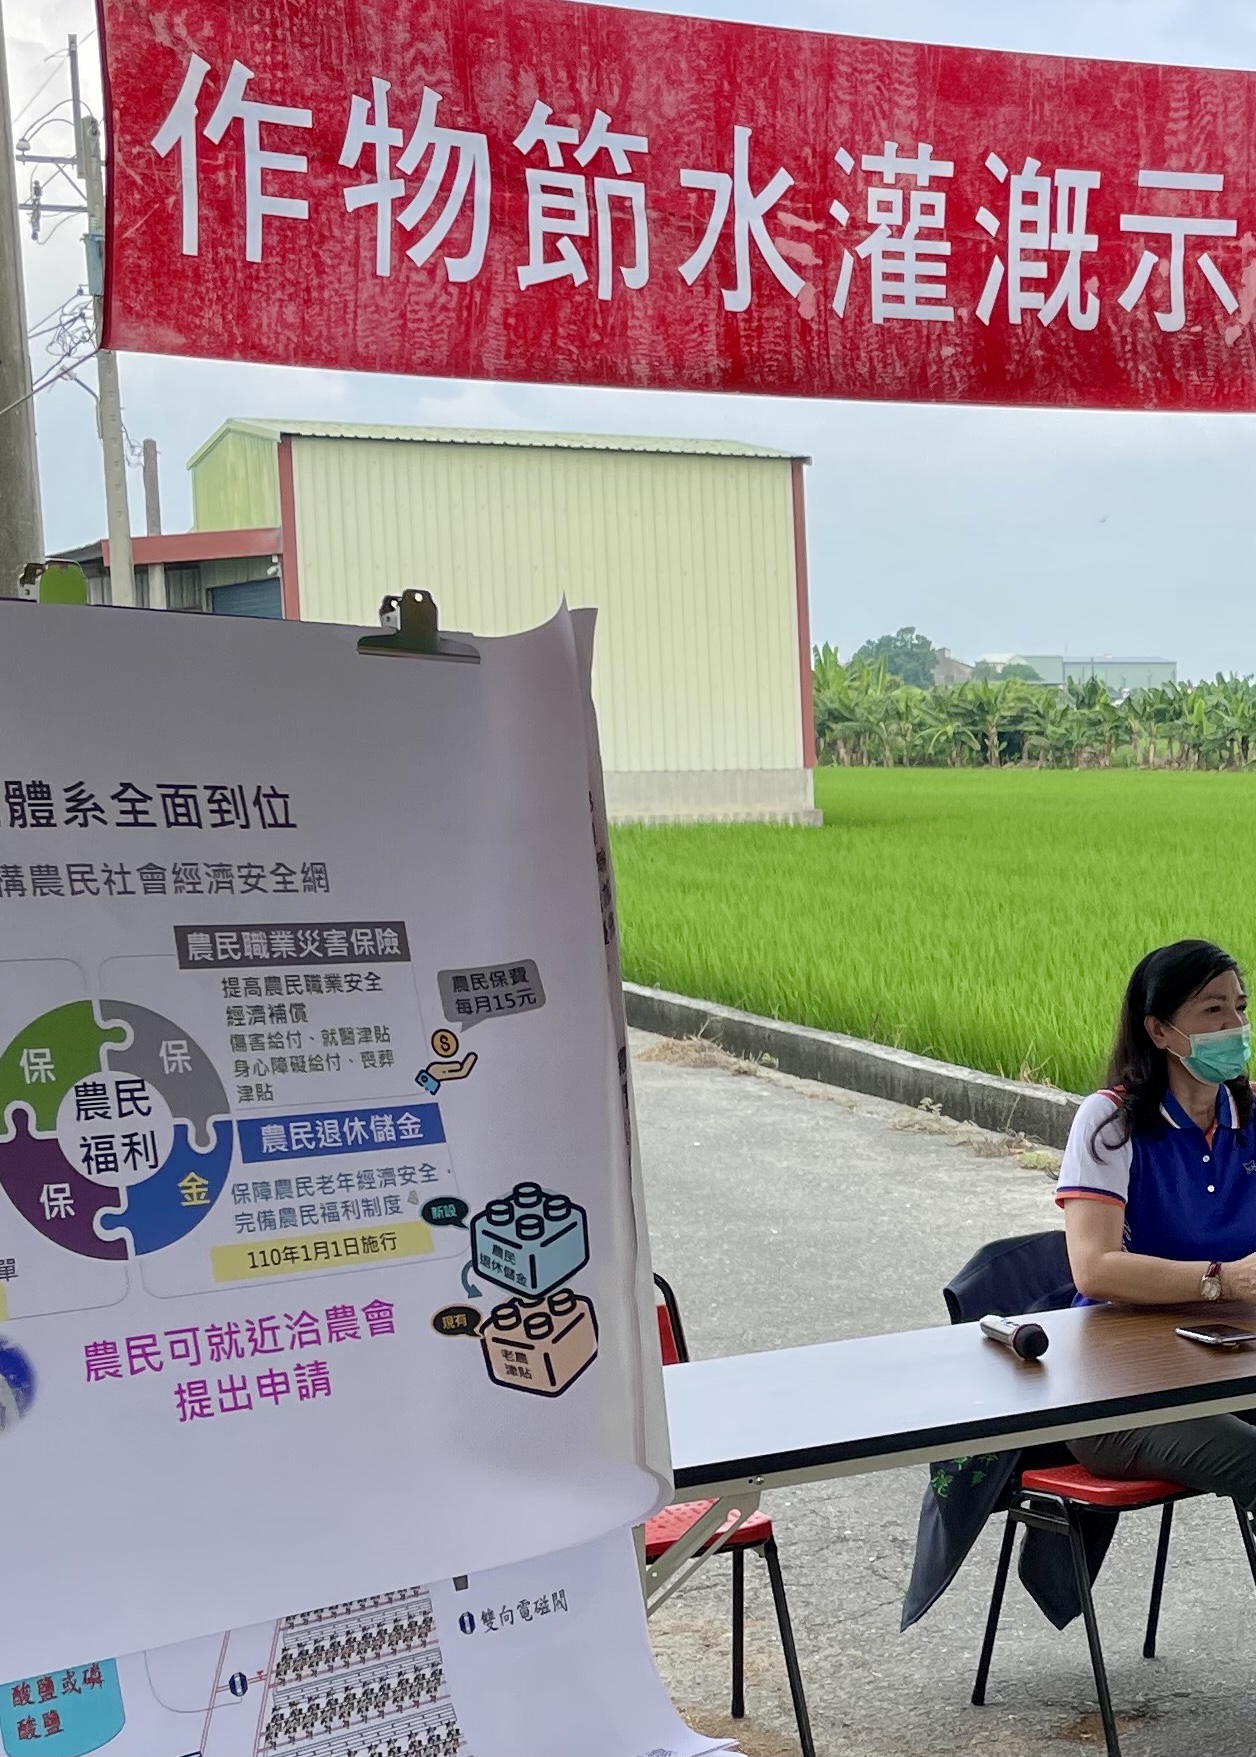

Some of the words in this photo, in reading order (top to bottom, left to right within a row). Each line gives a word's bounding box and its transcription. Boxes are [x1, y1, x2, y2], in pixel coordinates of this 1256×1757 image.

[3, 780, 298, 829] 體系全面到位
[187, 928, 401, 961] 農民職業災害保險
[221, 971, 384, 999] 提高農民職業安全
[452, 967, 529, 992] 農民保費
[226, 1002, 309, 1027] 經濟補償
[455, 988, 537, 1015] 每月15元
[20, 1048, 56, 1085] 保
[159, 1039, 192, 1075] 保
[74, 1078, 152, 1122] 農民
[236, 1083, 274, 1103] 津貼
[260, 1112, 423, 1154] 農民退休儲金
[80, 1130, 159, 1175] 福利
[39, 1183, 75, 1220] 保
[177, 1171, 211, 1207] 金
[234, 1194, 403, 1234] 完備農民福利制度
[247, 1232, 397, 1269] 110年1月1日施行
[83, 1299, 397, 1382] 農民可就近洽農會
[174, 1360, 332, 1423] 提出申請
